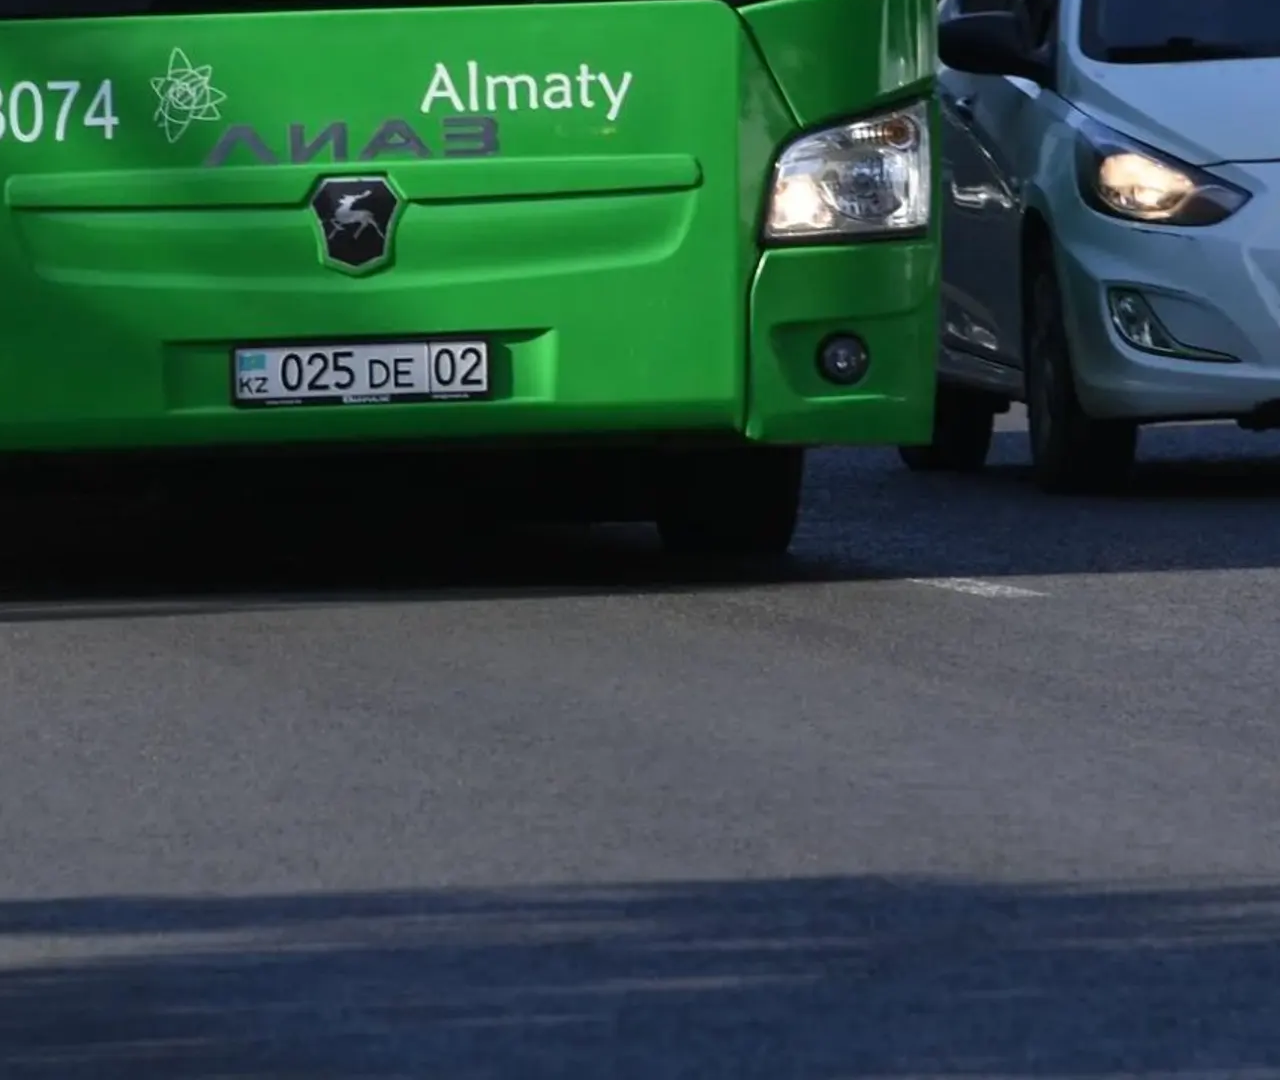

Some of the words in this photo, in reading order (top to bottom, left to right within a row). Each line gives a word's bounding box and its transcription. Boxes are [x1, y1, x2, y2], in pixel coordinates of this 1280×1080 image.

[419, 60, 633, 121] Almaty
[238, 376, 270, 394] KZ
[280, 351, 356, 392] 025
[368, 358, 415, 390] DE
[433, 347, 483, 387] 02
